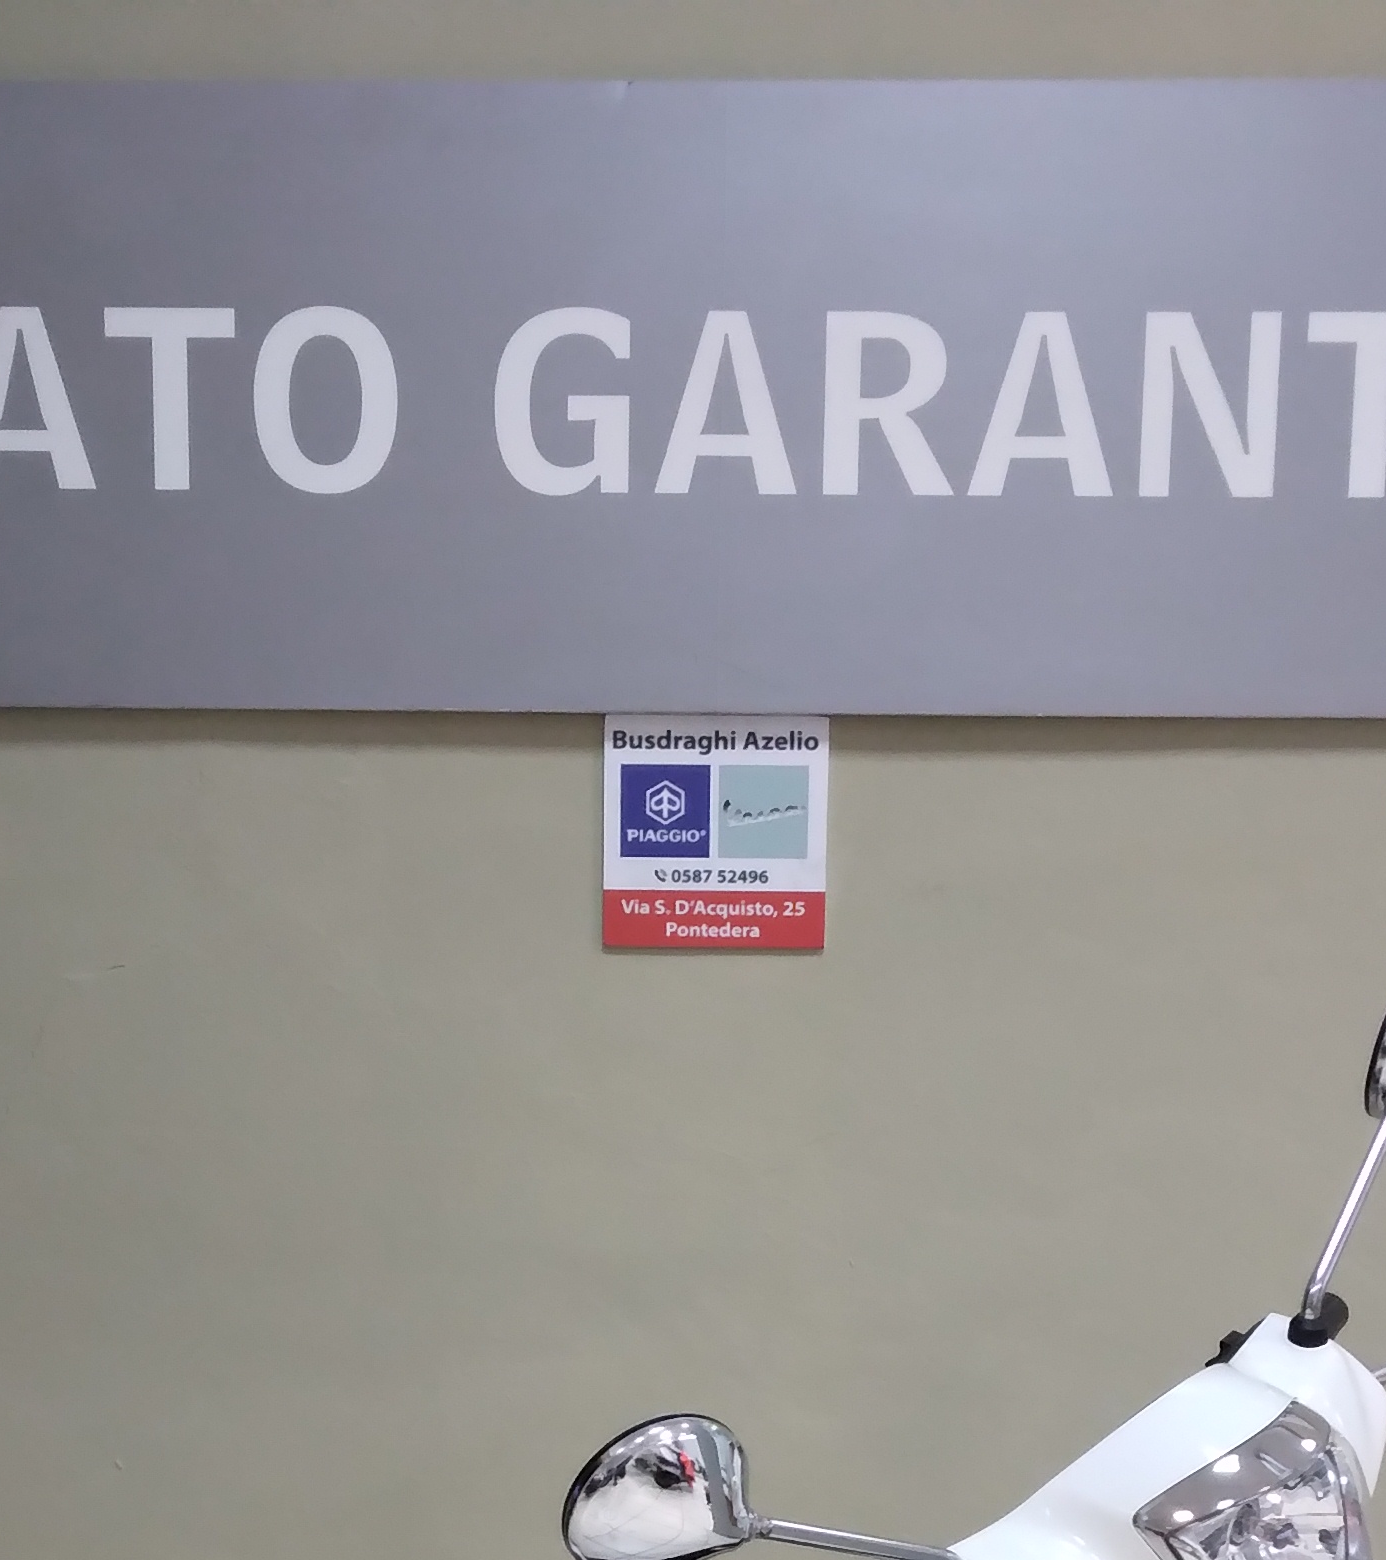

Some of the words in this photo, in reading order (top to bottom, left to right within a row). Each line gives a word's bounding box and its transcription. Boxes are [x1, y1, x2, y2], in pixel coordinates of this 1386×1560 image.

[613, 730, 736, 755] Busdraghi
[743, 730, 819, 751] Azelio
[626, 829, 701, 843] PIAGGIO
[671, 870, 713, 884] 0587
[717, 870, 769, 884] 52496
[621, 899, 650, 915] Via
[654, 899, 671, 915] S.
[675, 900, 778, 918] D'Acquisto,
[782, 901, 806, 916] 25
[665, 922, 760, 938] Pontedera
